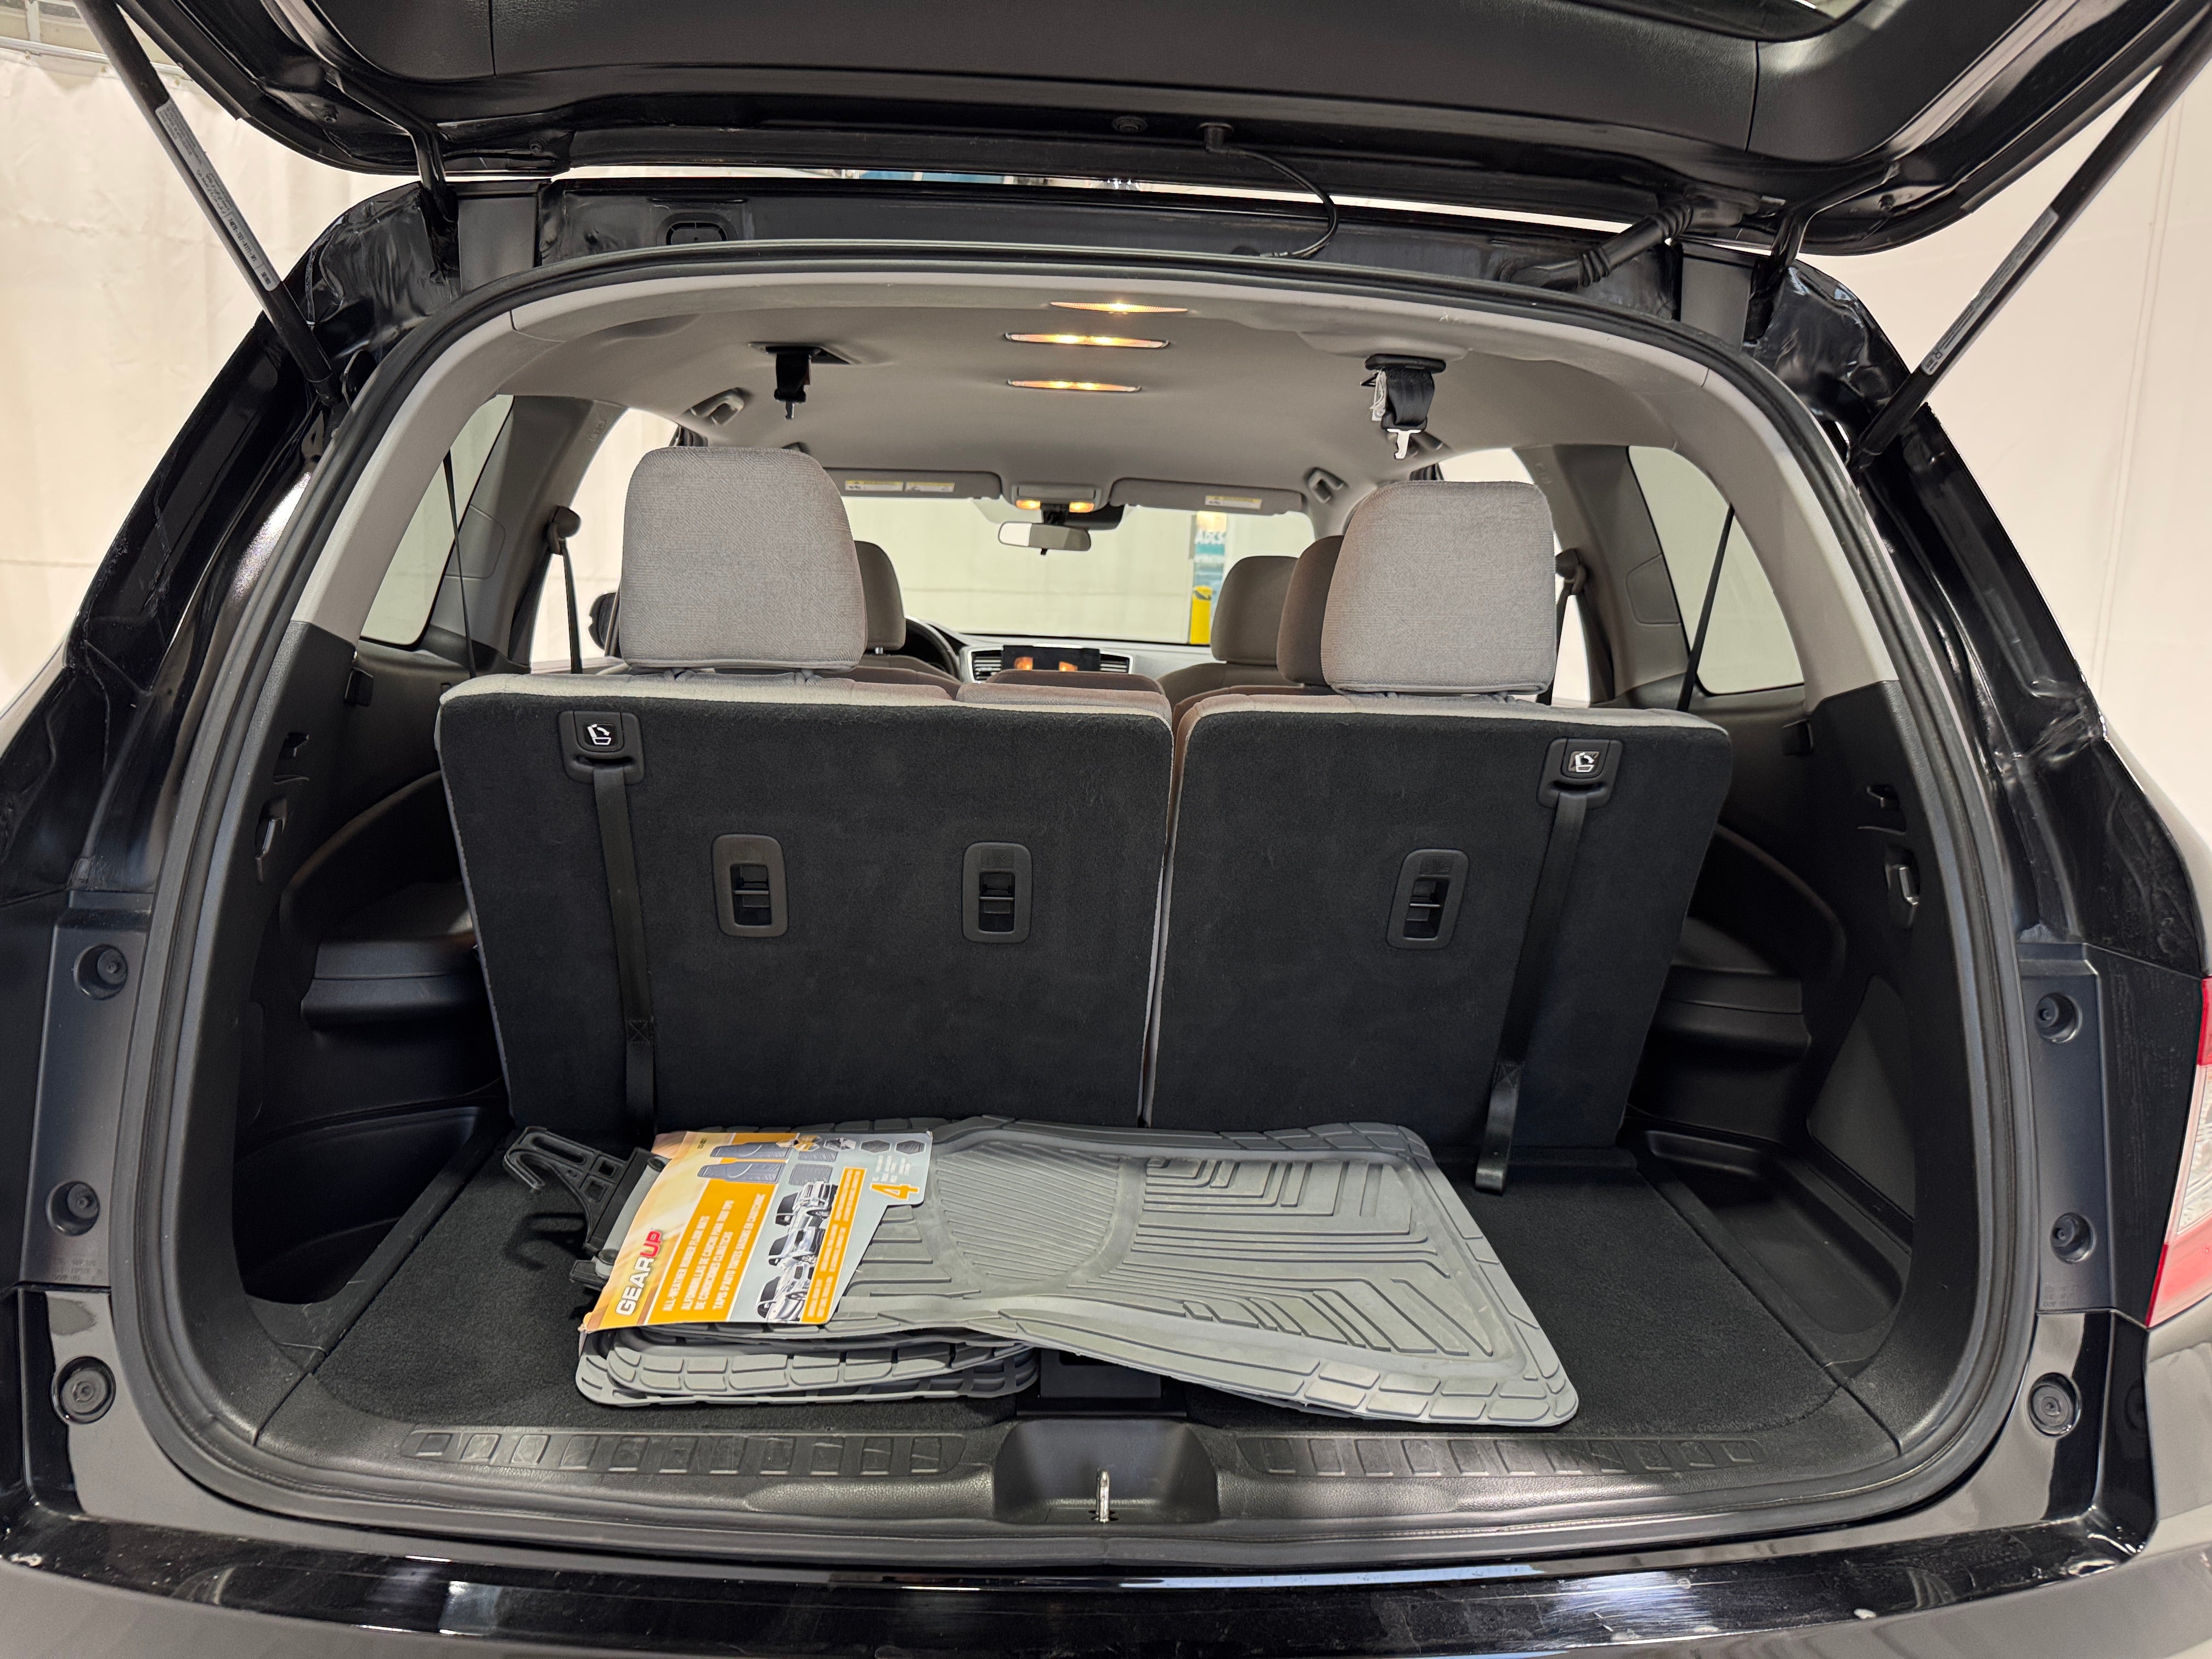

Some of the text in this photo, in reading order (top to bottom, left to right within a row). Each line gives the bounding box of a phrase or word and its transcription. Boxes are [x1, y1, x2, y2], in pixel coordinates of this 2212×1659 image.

[870, 1183, 920, 1200] 4
[616, 1229, 662, 1316] GEARUP
[662, 1268, 688, 1311] ALL-WEATHER
[712, 1291, 729, 1310] TAPIS
